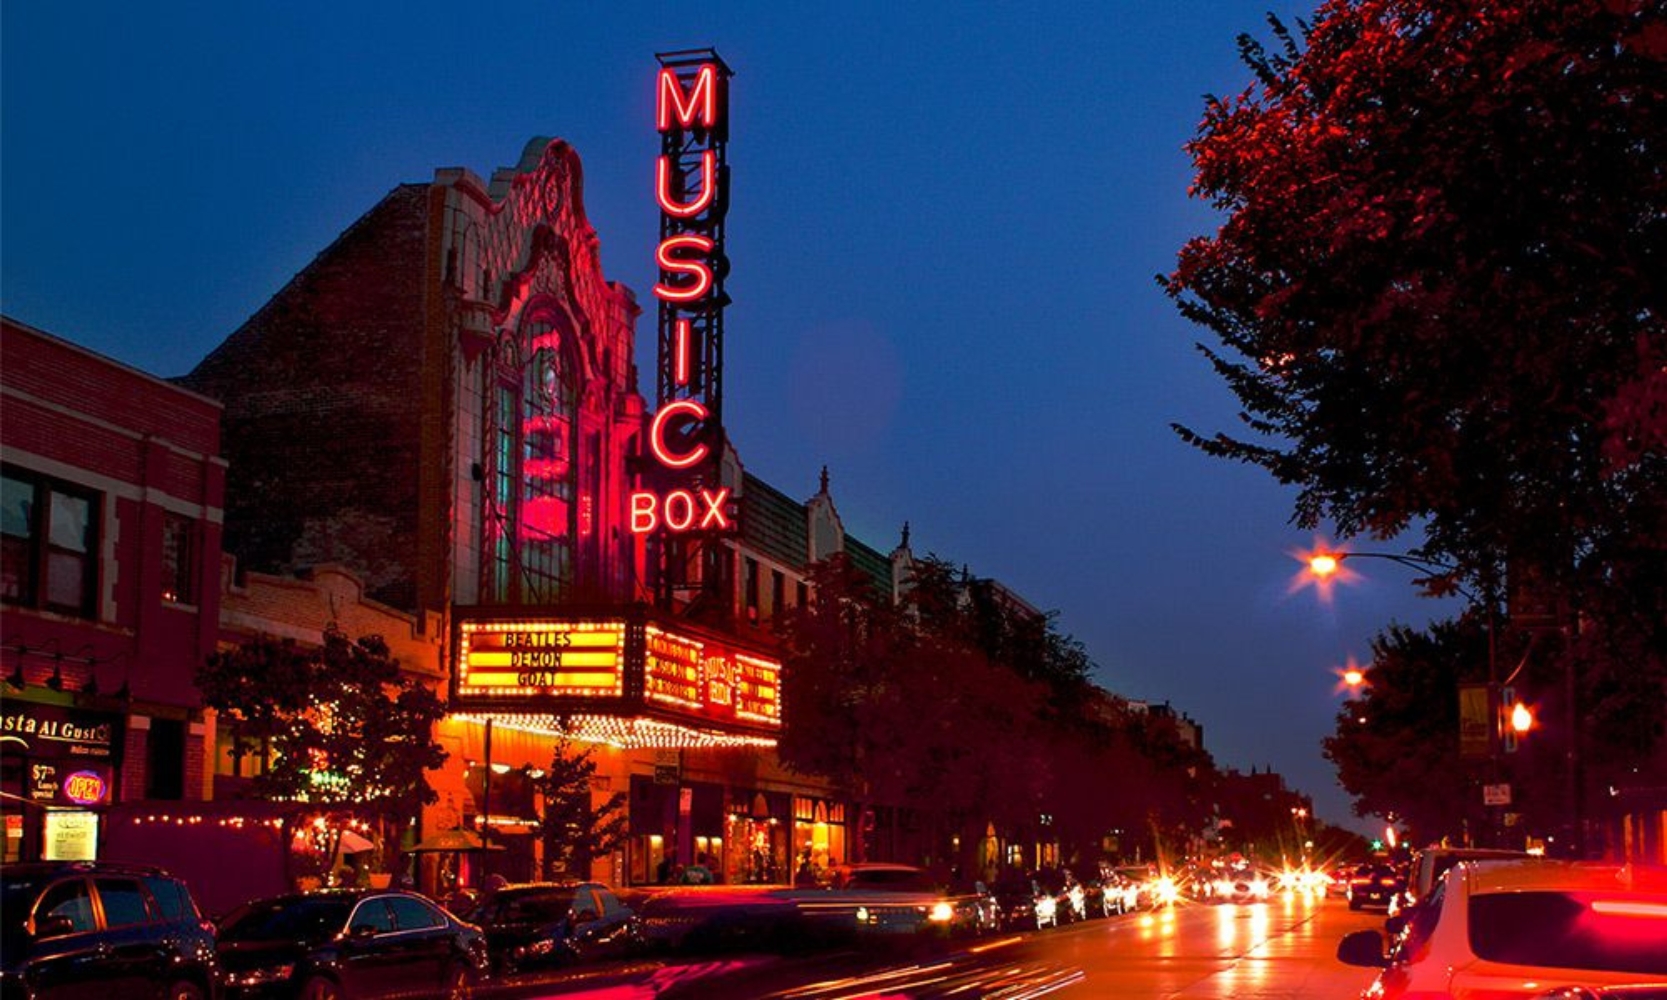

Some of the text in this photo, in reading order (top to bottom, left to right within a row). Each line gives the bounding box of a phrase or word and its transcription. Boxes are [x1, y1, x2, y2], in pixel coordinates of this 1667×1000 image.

[653, 63, 717, 469] MUSIC
[630, 488, 730, 534] BOX
[505, 632, 572, 648] BEATLES
[511, 652, 562, 668] DEMON
[517, 671, 556, 687] GOAT
[0, 714, 36, 733] sta
[39, 721, 58, 736] Al
[68, 775, 100, 801] OPEN
